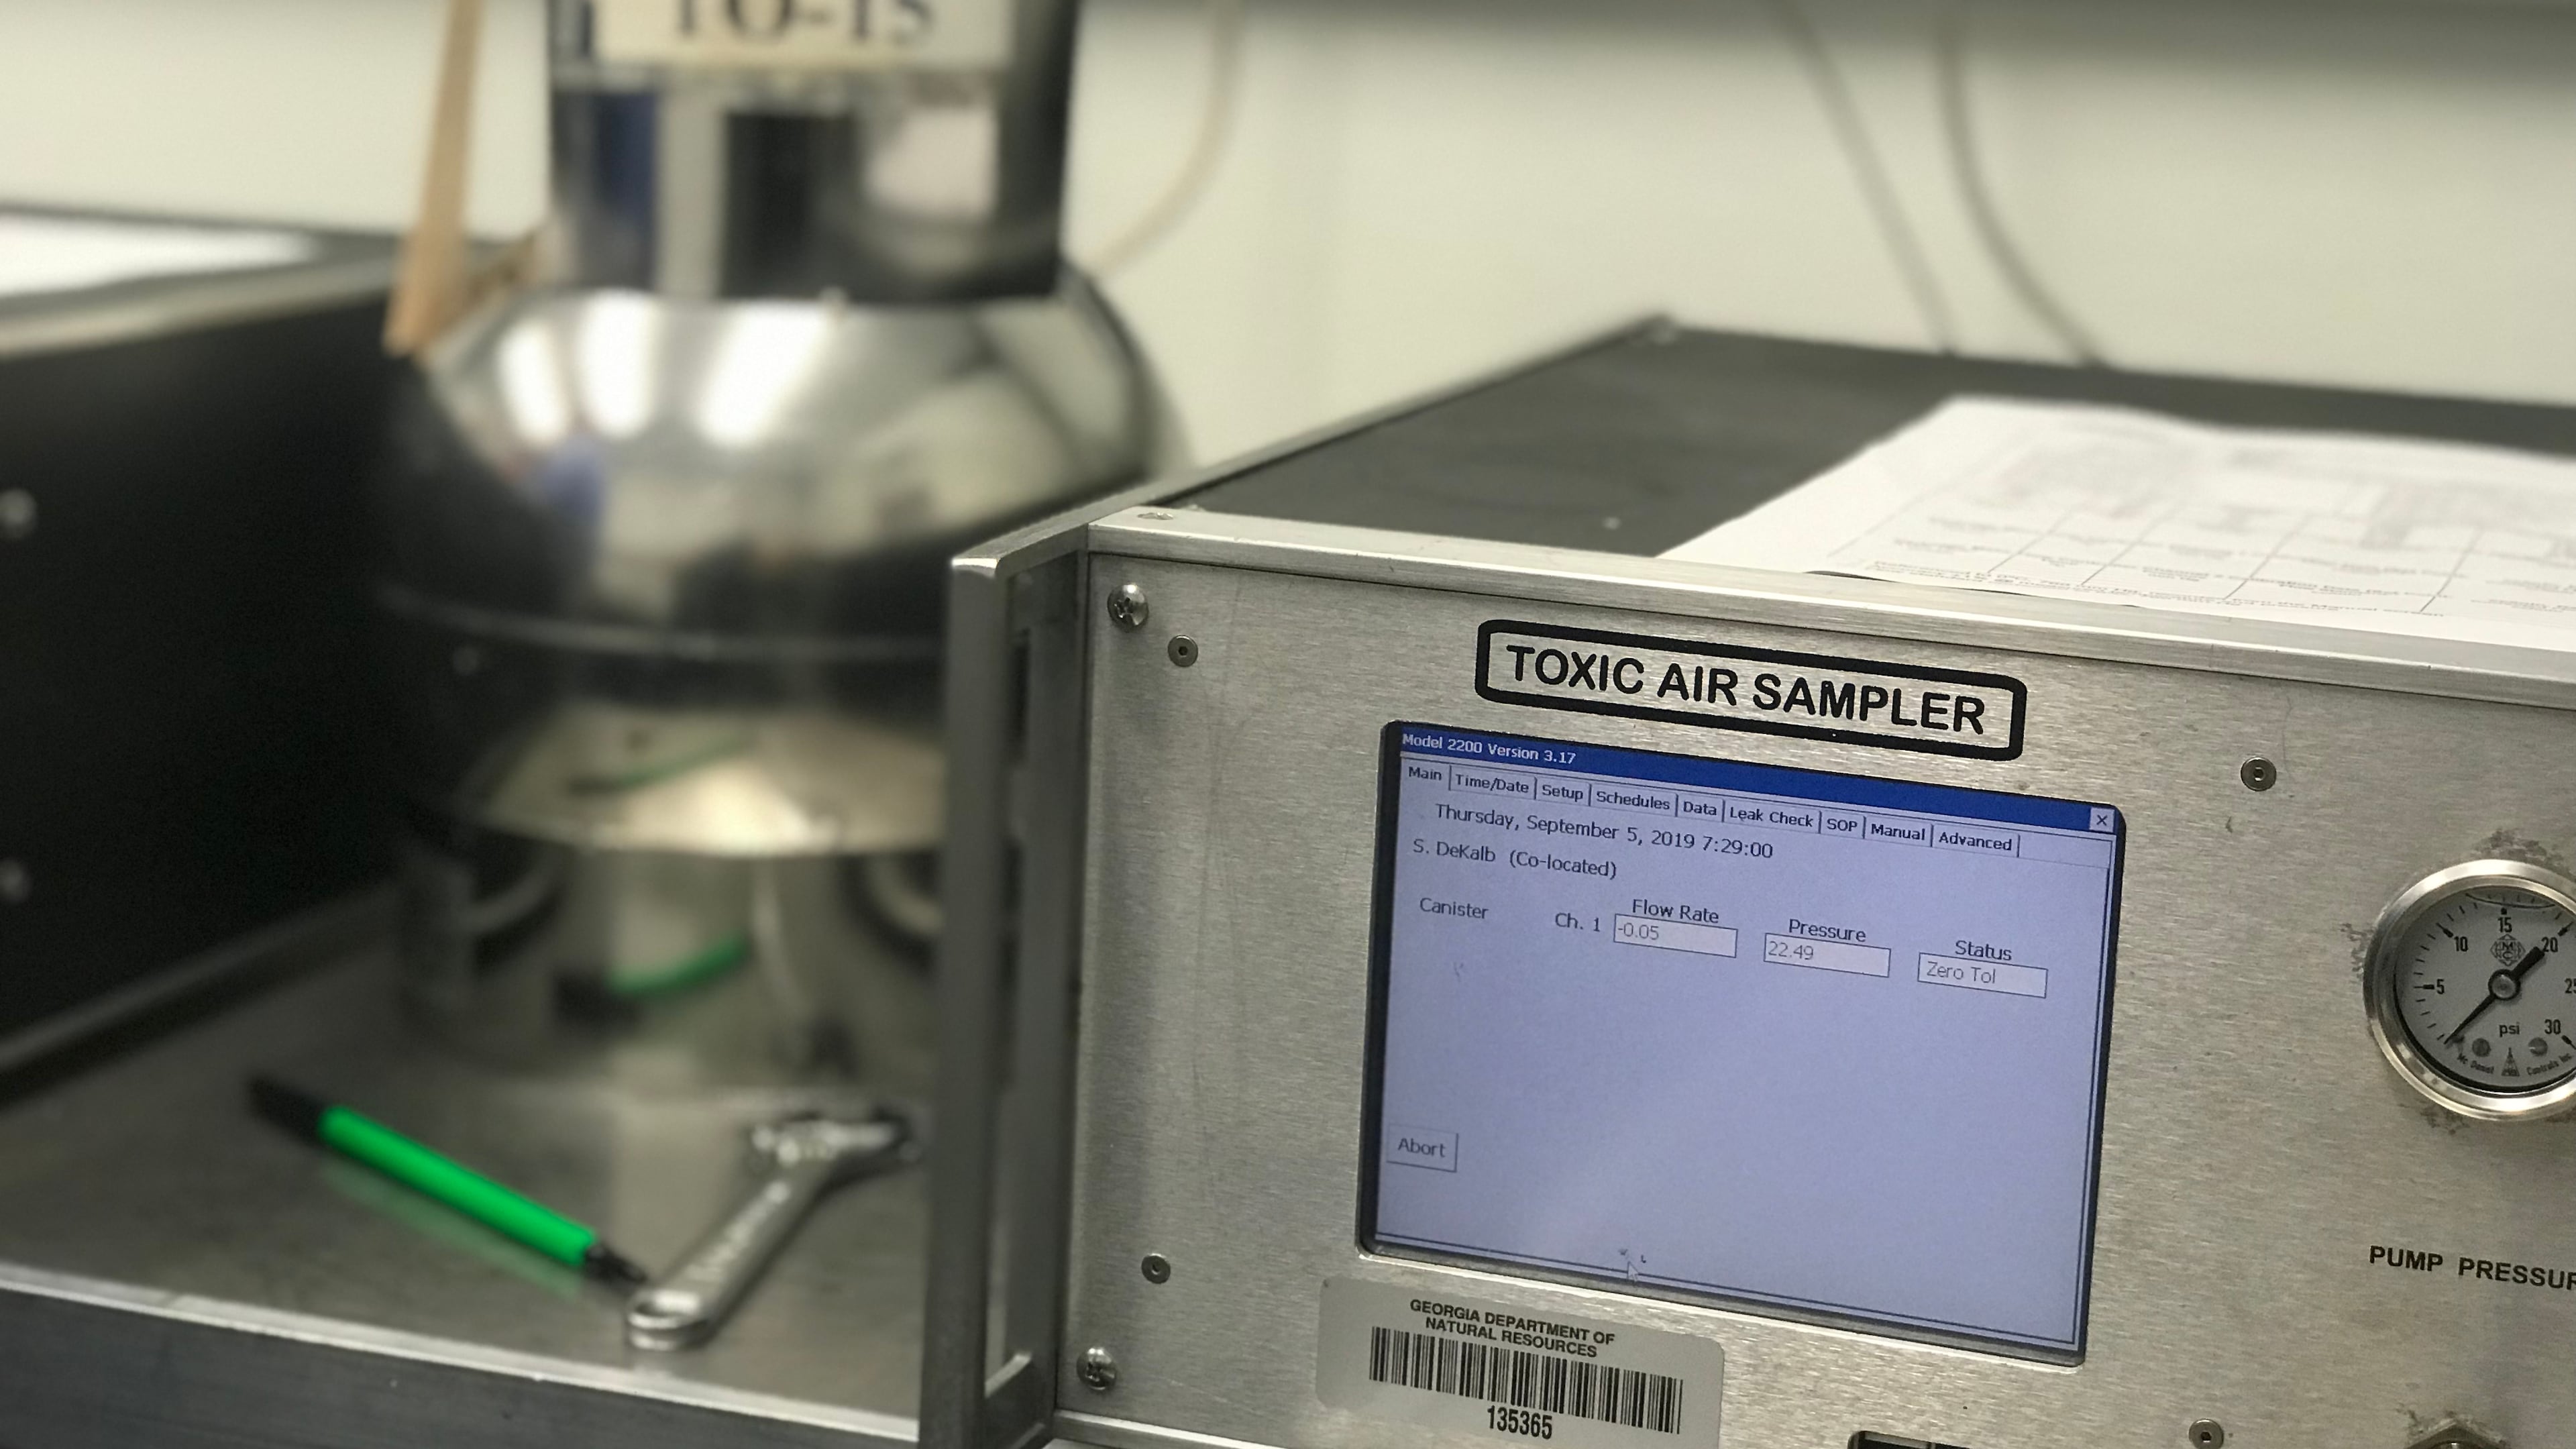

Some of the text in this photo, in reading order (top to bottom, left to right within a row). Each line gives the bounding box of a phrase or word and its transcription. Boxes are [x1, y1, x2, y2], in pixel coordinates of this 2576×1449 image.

[1505, 644, 1985, 735] TOXIC AIR SAMPLER
[1402, 733, 1576, 764] Model 2200 Version 3.17
[1409, 766, 2012, 851] Main Time/Date Setup Schedules Data Leak Check SOP Manual Advanced
[1436, 804, 1773, 859] Thursday, September 5, 2019 7:29:00
[1413, 839, 1617, 879] S. DeKalb (Co-located)
[1419, 898, 1489, 920] Canister
[1633, 900, 1719, 924] Flow Rate
[1555, 913, 1600, 932] Ch. 1
[1617, 924, 1659, 941] -0.05
[1789, 918, 1866, 943] Pressure
[2498, 917, 2512, 932] 15
[1768, 941, 1814, 960] 22.49
[1955, 941, 2012, 961] Status
[2455, 936, 2468, 952] 10
[2541, 937, 2558, 952] 20
[1927, 961, 1996, 984] Zero Tol
[2436, 979, 2445, 994] 5
[2499, 1022, 2520, 1036] psi
[2544, 1020, 2561, 1034] 30
[1397, 1137, 1446, 1158] Abort
[2369, 1245, 2443, 1271] PUMP
[1410, 1299, 1615, 1345] GEORGIA DEPARTMENT OF
[1426, 1317, 1597, 1358] NATURAL RESOURCES
[1487, 1405, 1552, 1440] 135365
